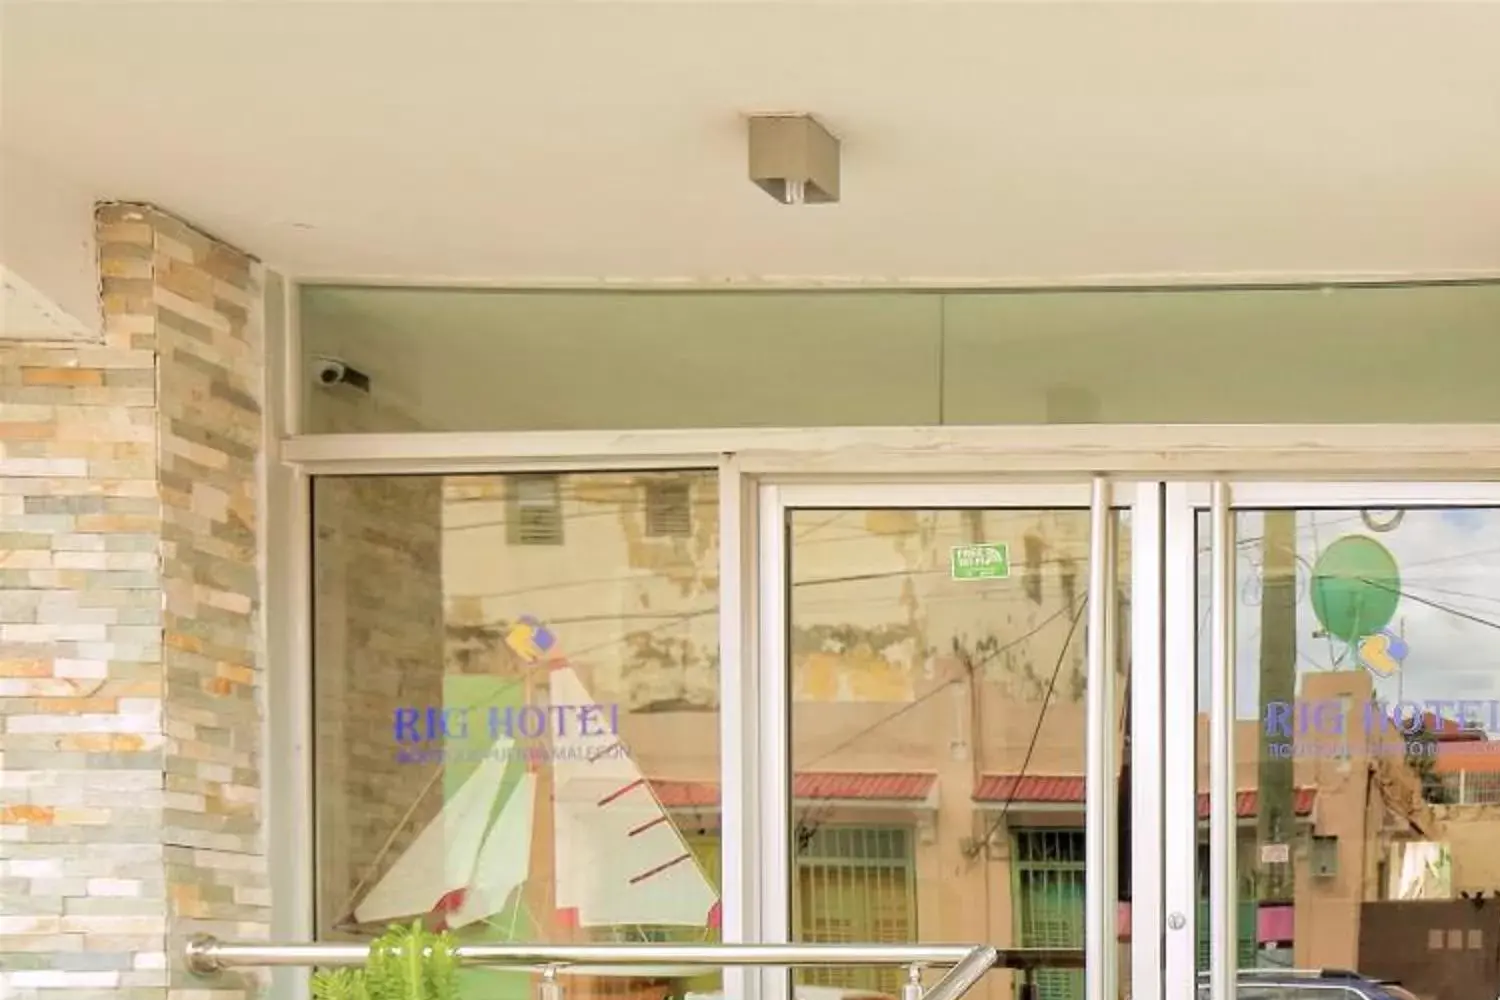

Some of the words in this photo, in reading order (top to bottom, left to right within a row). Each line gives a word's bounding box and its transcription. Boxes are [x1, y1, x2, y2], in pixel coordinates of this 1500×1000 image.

[393, 704, 469, 744] RIG
[486, 702, 624, 740] HOTEL
[1265, 700, 1345, 738] RIG
